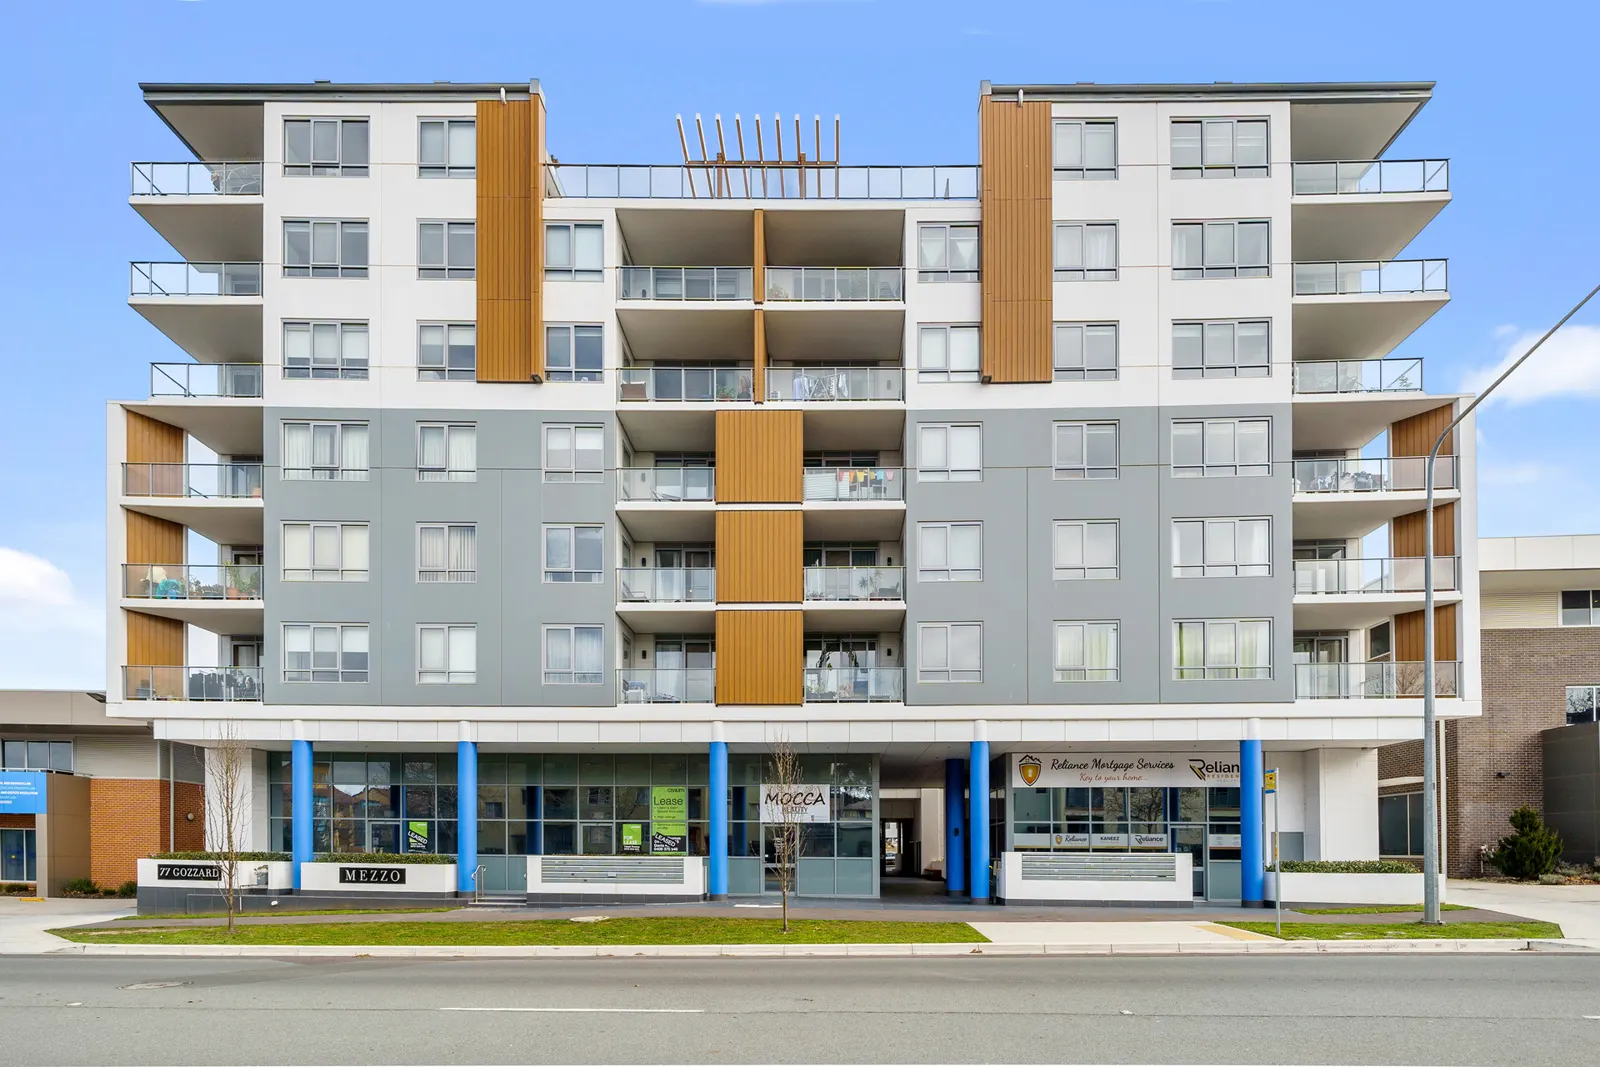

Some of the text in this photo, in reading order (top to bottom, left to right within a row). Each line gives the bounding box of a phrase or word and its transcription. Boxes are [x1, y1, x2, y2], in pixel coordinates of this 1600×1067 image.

[1051, 758, 1175, 772] Reliance Mortgage Services
[1080, 772, 1093, 783] Key
[1095, 773, 1102, 781] to
[1104, 775, 1120, 783] your
[653, 796, 684, 806] Lease
[764, 791, 826, 806] MOCCA
[408, 830, 428, 845] LEASED
[655, 833, 676, 847] LEASED
[1064, 834, 1088, 843] Reliance
[160, 867, 219, 878] 77 GOZZARD
[345, 869, 401, 882] MEZZO
